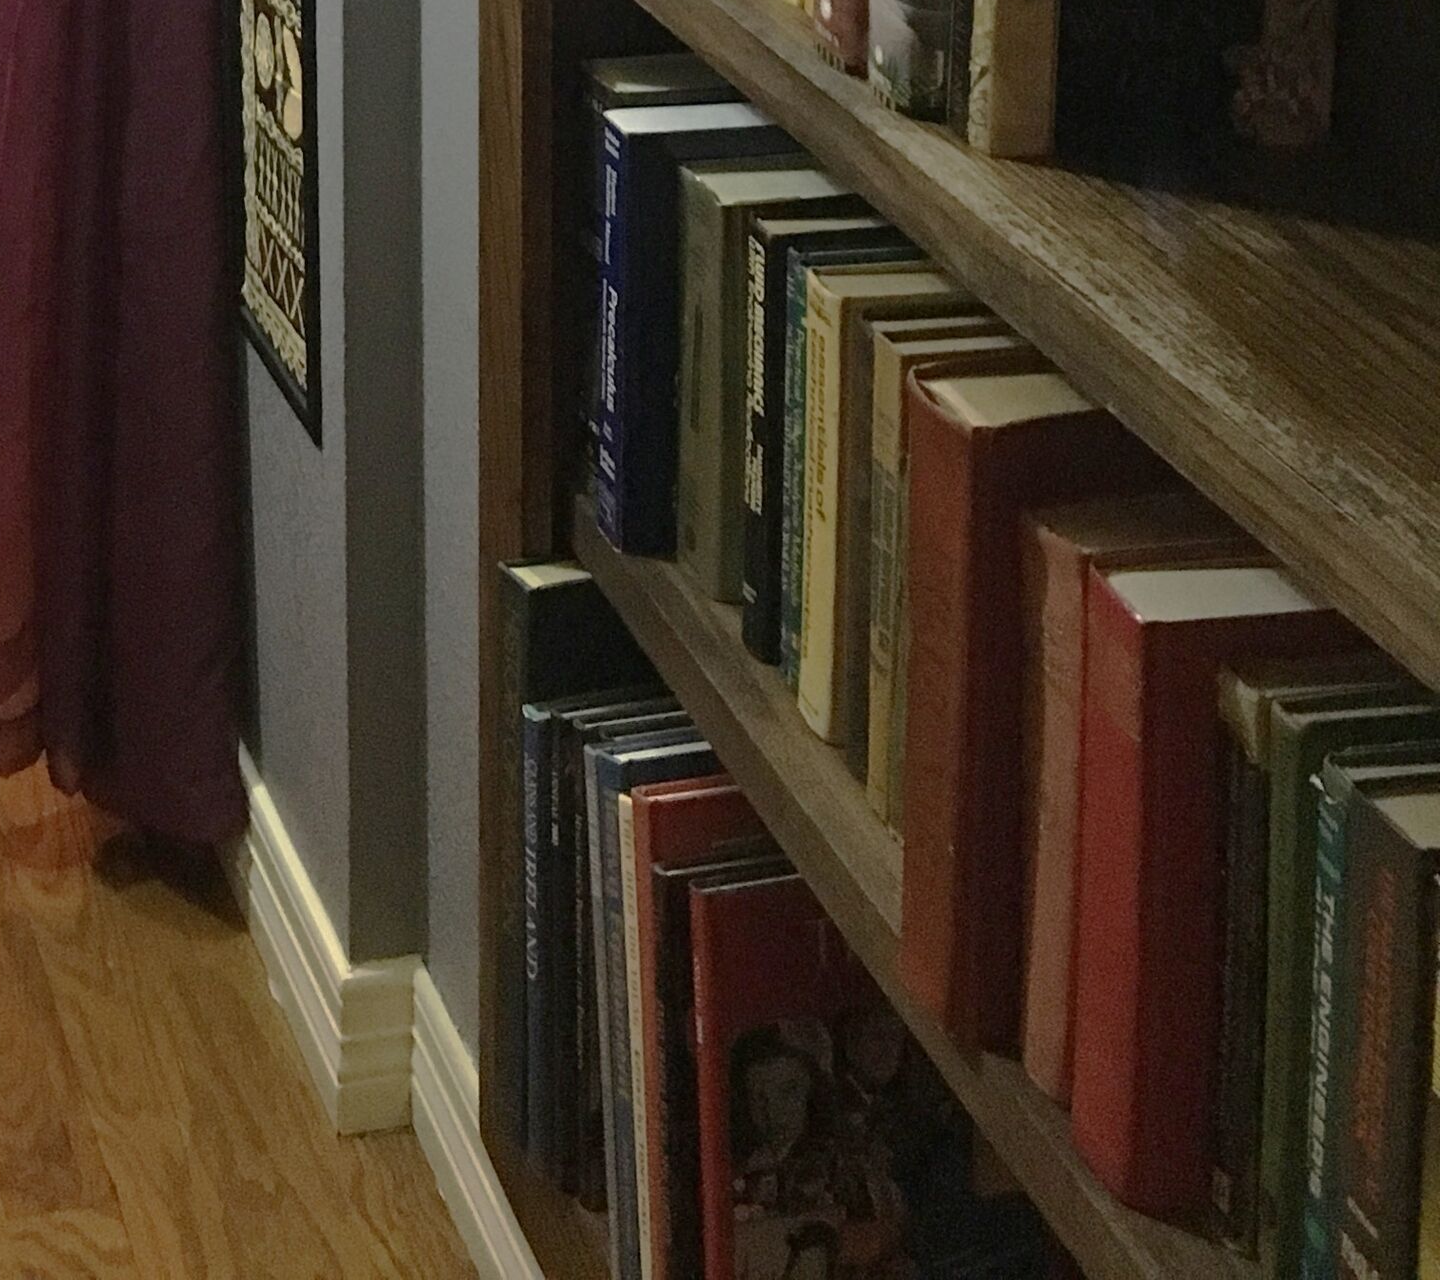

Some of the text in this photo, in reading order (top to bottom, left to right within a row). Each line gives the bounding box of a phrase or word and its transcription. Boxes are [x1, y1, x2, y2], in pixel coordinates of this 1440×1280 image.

[606, 285, 618, 414] Precalculus
[753, 237, 766, 417] FLUID MECHANICS
[814, 334, 828, 522] essentials of
[526, 847, 539, 981] IRELAND
[1320, 894, 1335, 966] THE
